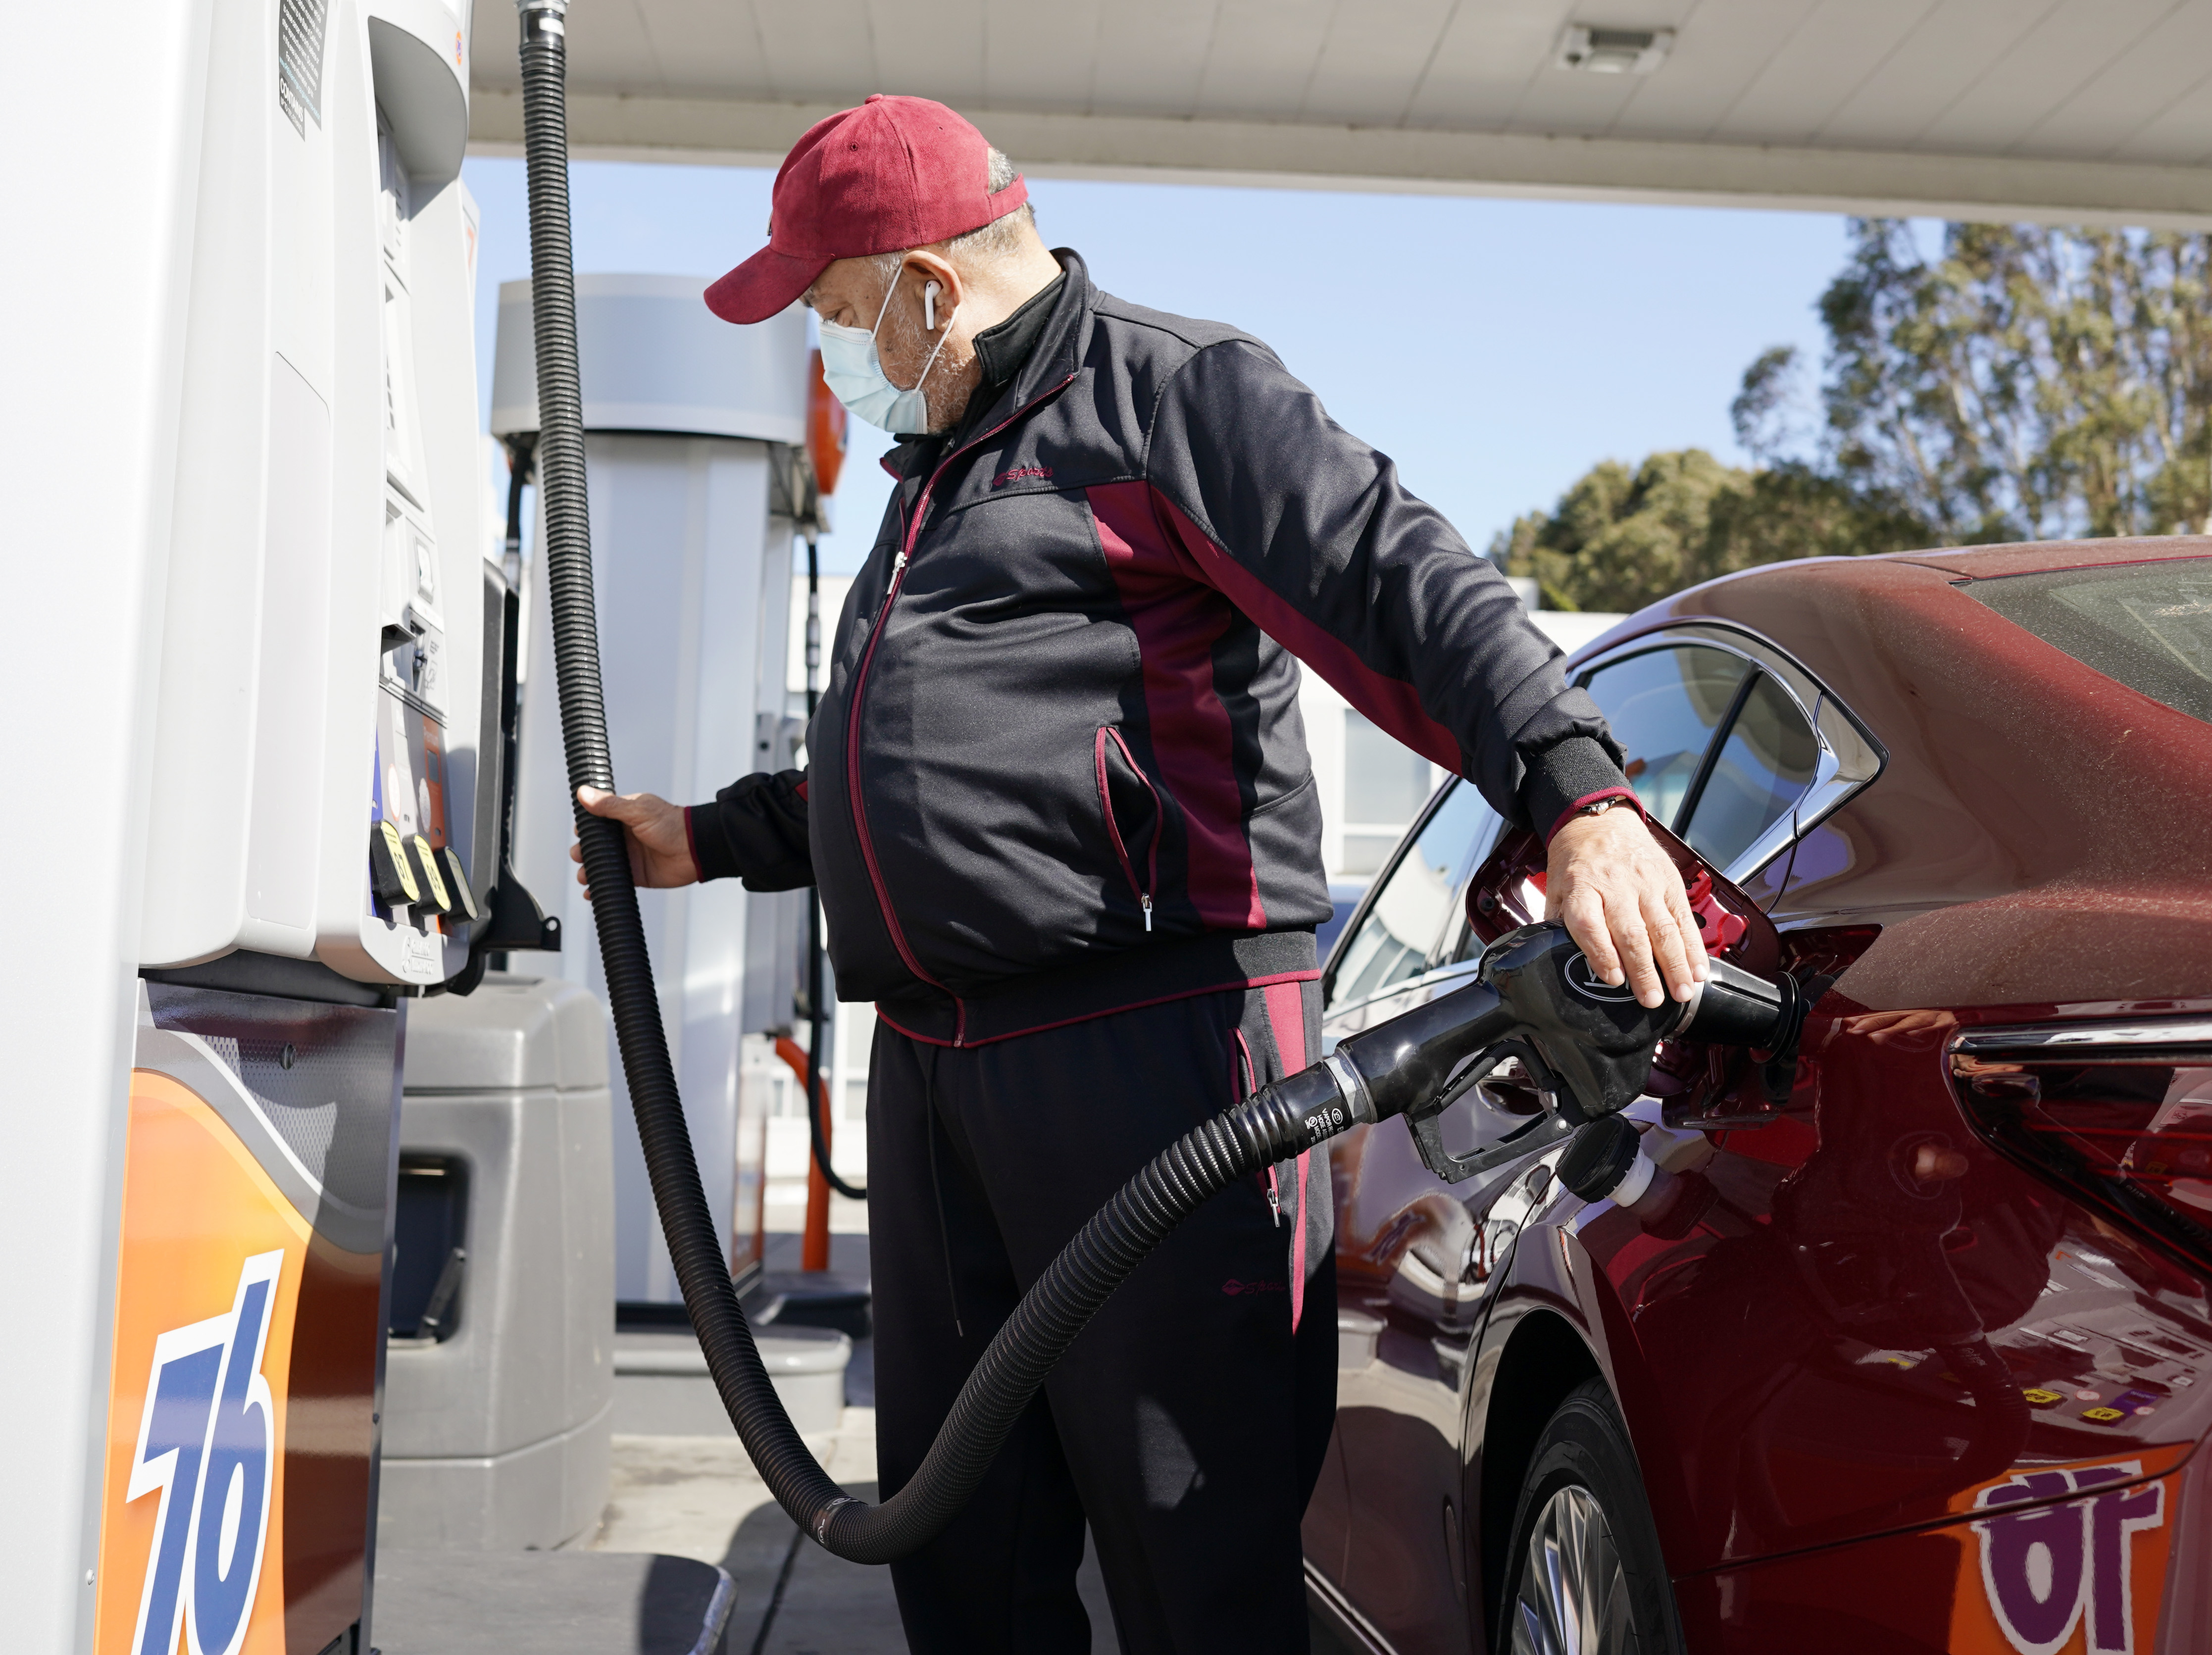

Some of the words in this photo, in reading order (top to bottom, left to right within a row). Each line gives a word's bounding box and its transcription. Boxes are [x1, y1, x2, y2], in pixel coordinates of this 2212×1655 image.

[1006, 466, 1054, 482] Sports
[394, 852, 409, 882] 87
[1317, 1114, 1326, 1129] HOSE
[1322, 1107, 1332, 1127] VAPOR
[126, 1248, 285, 1655] 76
